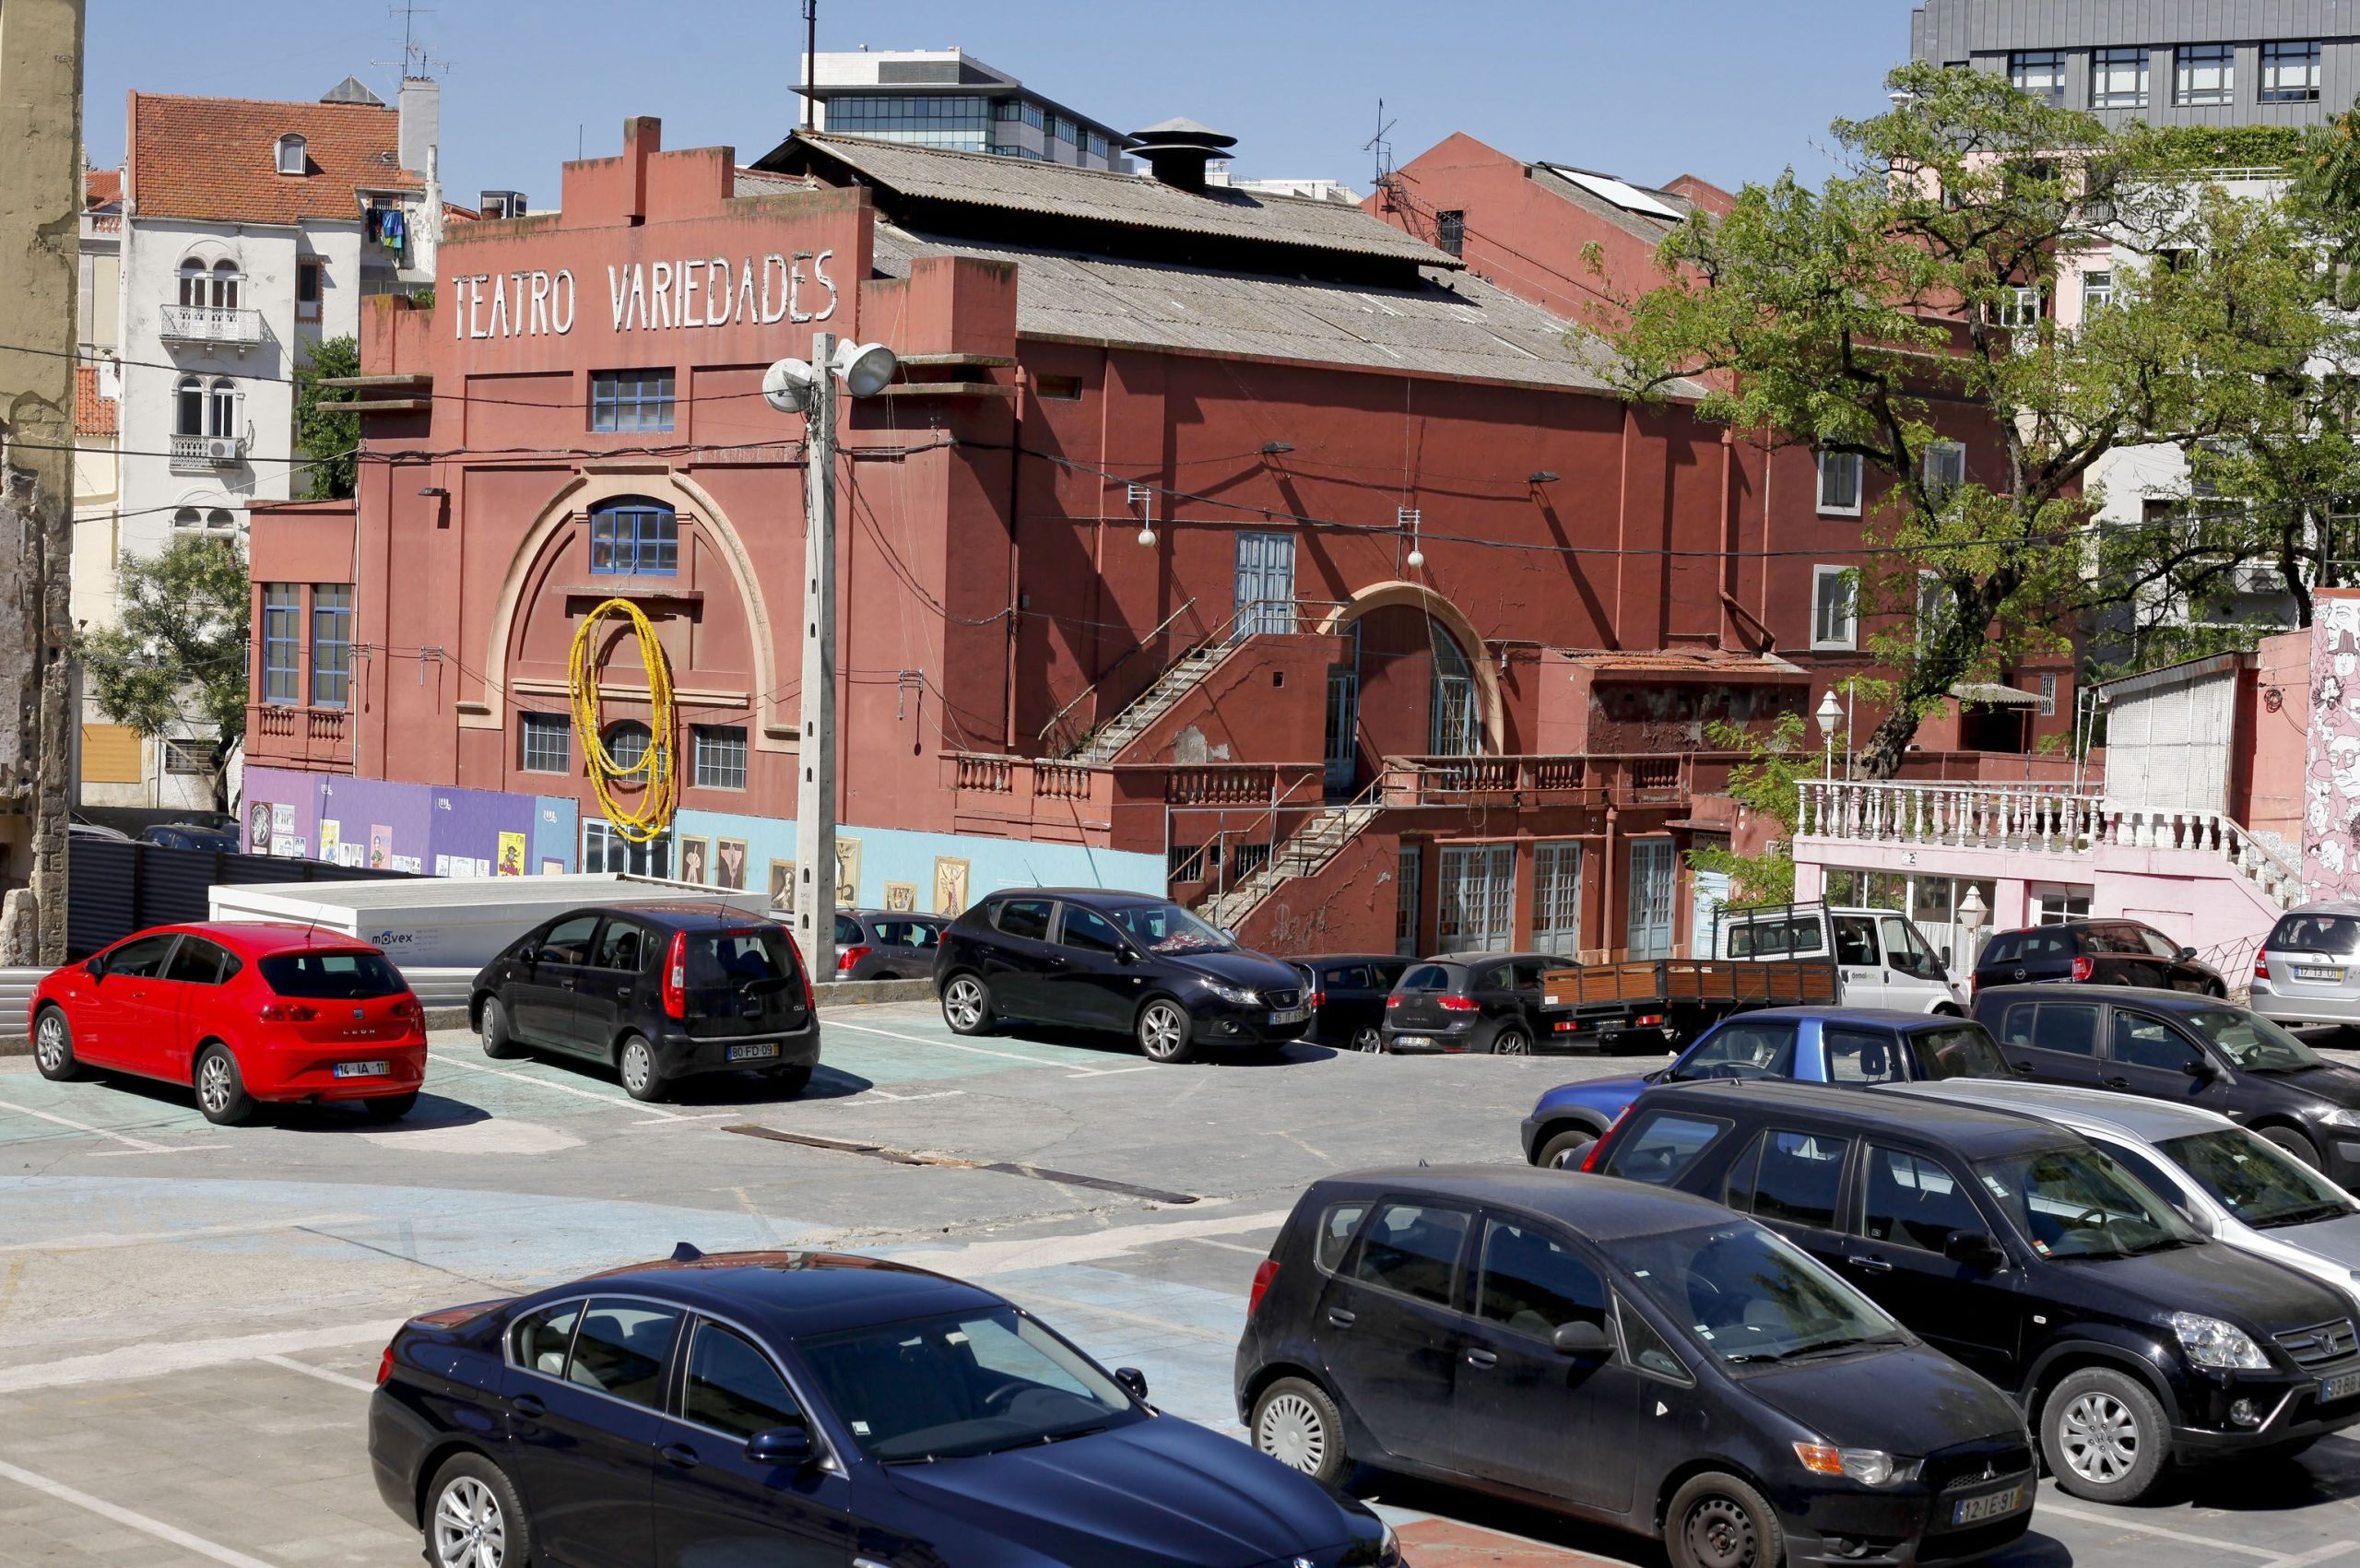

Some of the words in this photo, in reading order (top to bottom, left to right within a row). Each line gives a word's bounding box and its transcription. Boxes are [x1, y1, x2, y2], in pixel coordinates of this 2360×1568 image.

[452, 268, 576, 339] TEATRO
[608, 248, 839, 332] VARIEDADES
[372, 931, 413, 945] movex
